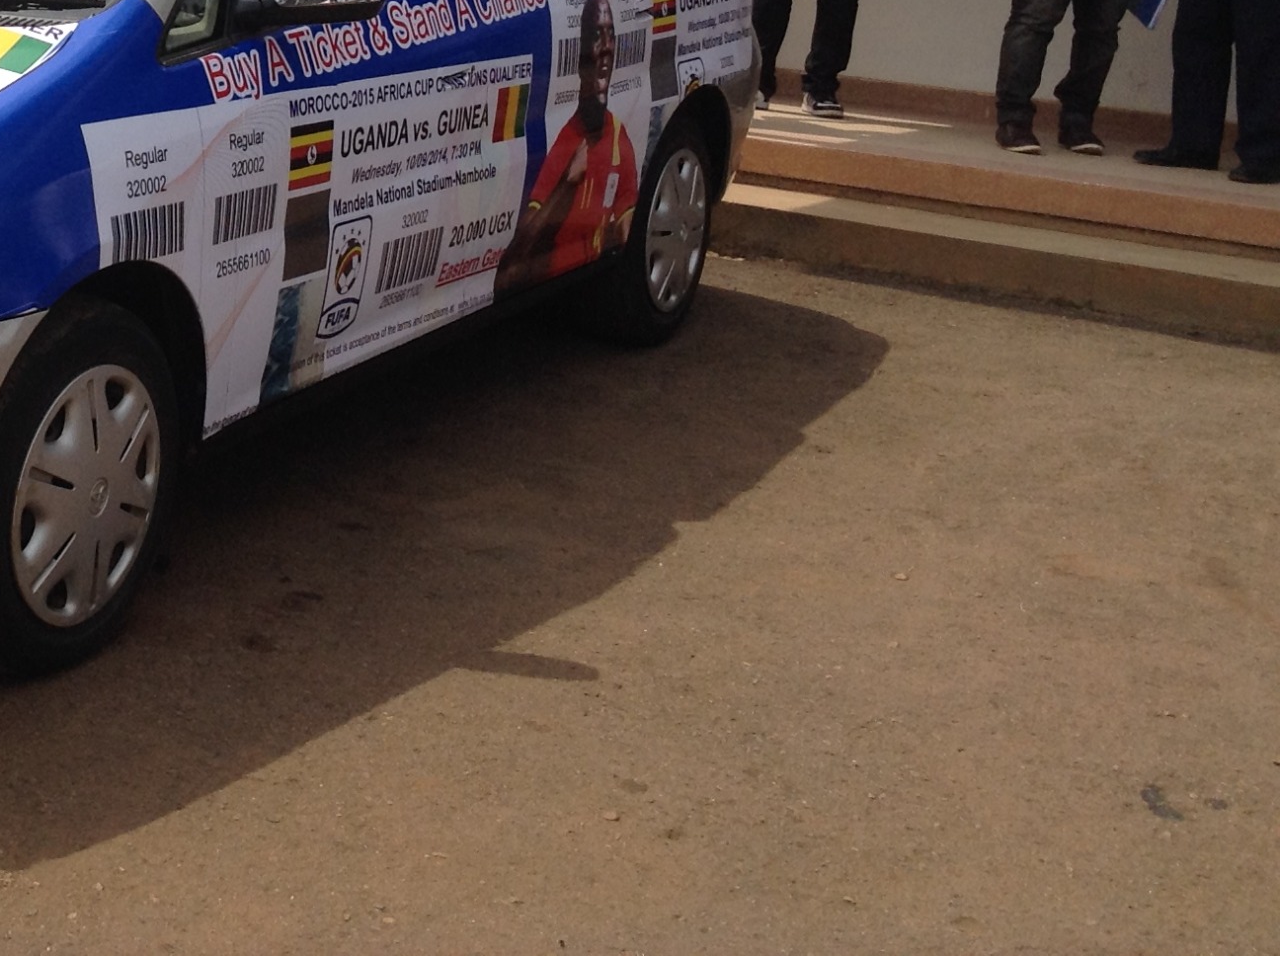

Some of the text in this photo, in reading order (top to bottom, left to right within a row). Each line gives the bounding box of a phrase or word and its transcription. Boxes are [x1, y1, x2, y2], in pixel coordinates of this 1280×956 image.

[200, 48, 261, 104] Buy
[266, 35, 295, 86] A
[284, 21, 370, 78] Ticket
[368, 14, 392, 56] &
[289, 86, 375, 119] MOROCCO-2015
[376, 79, 413, 104] AFRICA
[414, 77, 435, 97] CUP
[489, 62, 532, 84] QUALIFIER
[228, 129, 265, 152] Regular
[340, 103, 490, 158] UGANDA vs. GUINEA
[124, 145, 169, 170] Regular
[231, 156, 265, 179] 320002
[351, 160, 403, 185] Wednesday,
[450, 142, 469, 161] 7:30
[468, 139, 482, 157] PM
[126, 175, 168, 199] 320002
[333, 162, 498, 217] Mandela National Stadium-Namboole
[401, 209, 429, 230] 320002
[448, 210, 516, 249] 20,000 UGX
[216, 248, 271, 279] 2655661100
[436, 254, 481, 284] Eastern
[324, 306, 352, 329] FUFA
